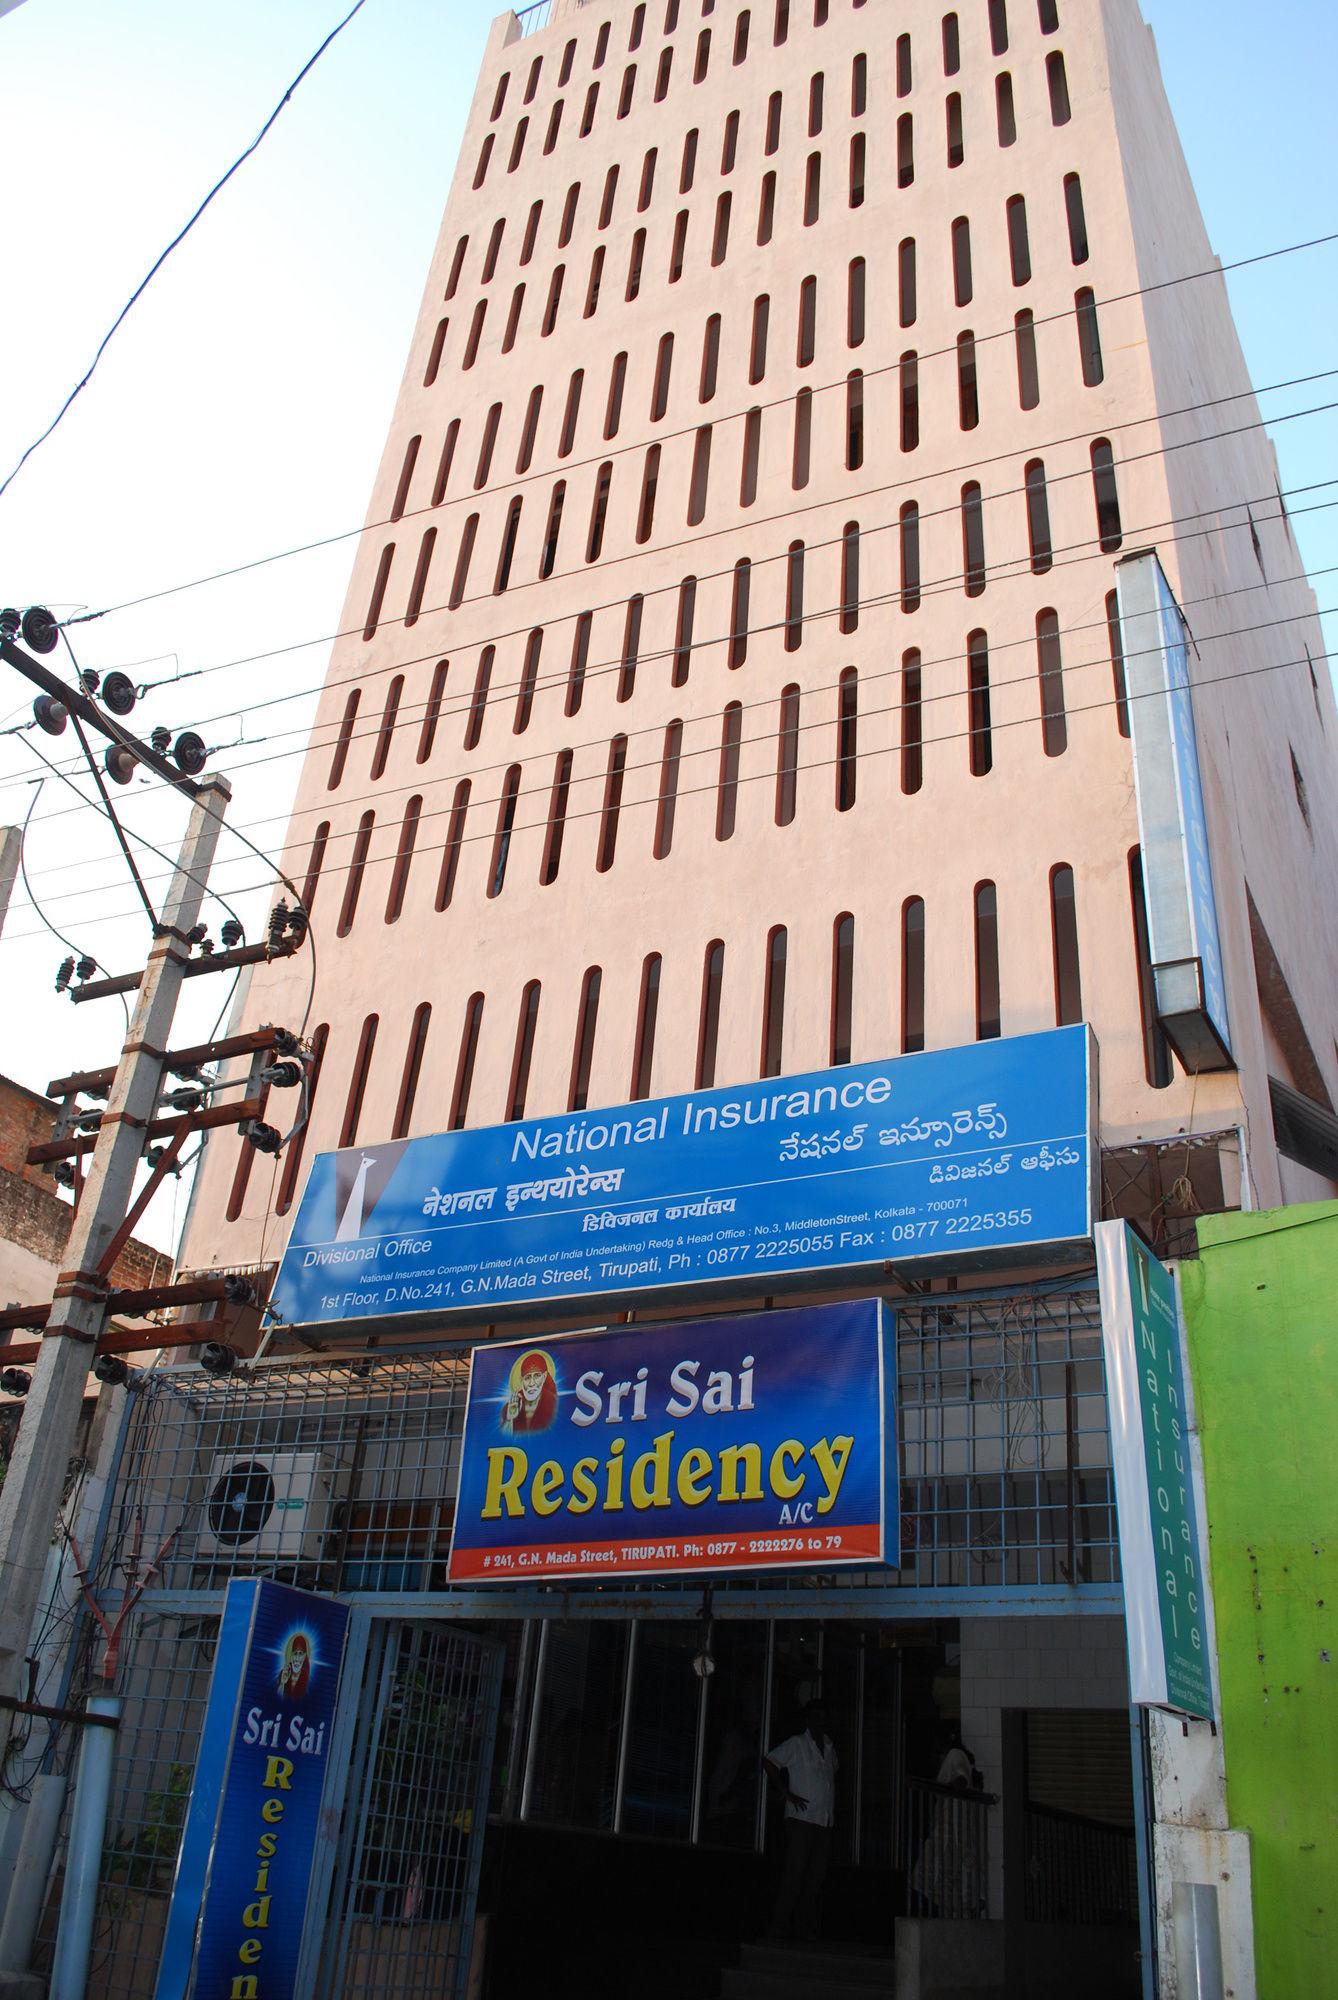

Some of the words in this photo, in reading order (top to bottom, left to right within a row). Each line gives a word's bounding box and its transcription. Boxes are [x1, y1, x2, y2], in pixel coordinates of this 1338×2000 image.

[510, 1103, 669, 1163] National
[682, 1076, 893, 1136] Insurance
[779, 1123, 869, 1162] నేషనల్
[879, 1102, 1008, 1148] ఇన్సూరెన్స్
[929, 1153, 1013, 1184] డివిజనల్
[1020, 1146, 1081, 1171] ఆఫీసు
[422, 1186, 498, 1217] नेशनल
[582, 1208, 660, 1232] डिविजनल
[665, 1197, 737, 1221] कार्यालय
[303, 1242, 380, 1267] Divisional
[385, 1239, 432, 1257] Office
[320, 1295, 339, 1309] 1st
[342, 1291, 380, 1307] Floor,
[384, 1281, 455, 1303] D.No.241,
[461, 1271, 537, 1294] G.N.Mada
[541, 1265, 592, 1285] Street,
[599, 1257, 662, 1278] Tirupati,
[668, 1253, 691, 1270] Ph
[707, 1244, 751, 1265] 0877
[755, 1234, 834, 1259] 2225055
[840, 1231, 875, 1248] Fax
[891, 1220, 940, 1242] 0877
[945, 1208, 1033, 1235] 2225355
[360, 1272, 394, 1284] National
[394, 1268, 435, 1280] Insurance
[437, 1263, 478, 1276] Company
[480, 1257, 511, 1270] Limited
[513, 1256, 526, 1268] (A
[525, 1254, 547, 1265] Govt
[549, 1252, 560, 1262] of
[561, 1250, 583, 1260] India
[585, 1240, 646, 1258] Undertaking)
[648, 1237, 674, 1250] Redg
[676, 1236, 684, 1246] &
[686, 1232, 714, 1244] Head
[716, 1228, 746, 1240] Office
[784, 1211, 871, 1232] MiddletonStreet,
[874, 1206, 916, 1220] Kolkata
[926, 1197, 968, 1212] 700071
[570, 1367, 649, 1428] Sri
[665, 1355, 756, 1419] Sai
[480, 1430, 856, 1522] Residency
[1140, 1320, 1178, 1638] National
[1167, 1348, 1201, 1651] Insurance
[778, 1502, 814, 1525] A/C
[483, 1556, 491, 1568] #
[493, 1554, 515, 1569] 241,
[518, 1552, 543, 1566] G.N.
[545, 1550, 577, 1565] Mada
[580, 1549, 618, 1564] Street,
[621, 1544, 680, 1561] TIRUPATI.
[683, 1543, 704, 1558] Ph:
[707, 1542, 738, 1556] 0877
[749, 1538, 804, 1553] 2222276
[807, 1537, 822, 1550] to
[825, 1535, 843, 1549] 79
[243, 1706, 282, 1748] Sri
[286, 1715, 326, 1756] Sai
[229, 1755, 295, 2000] Residen
